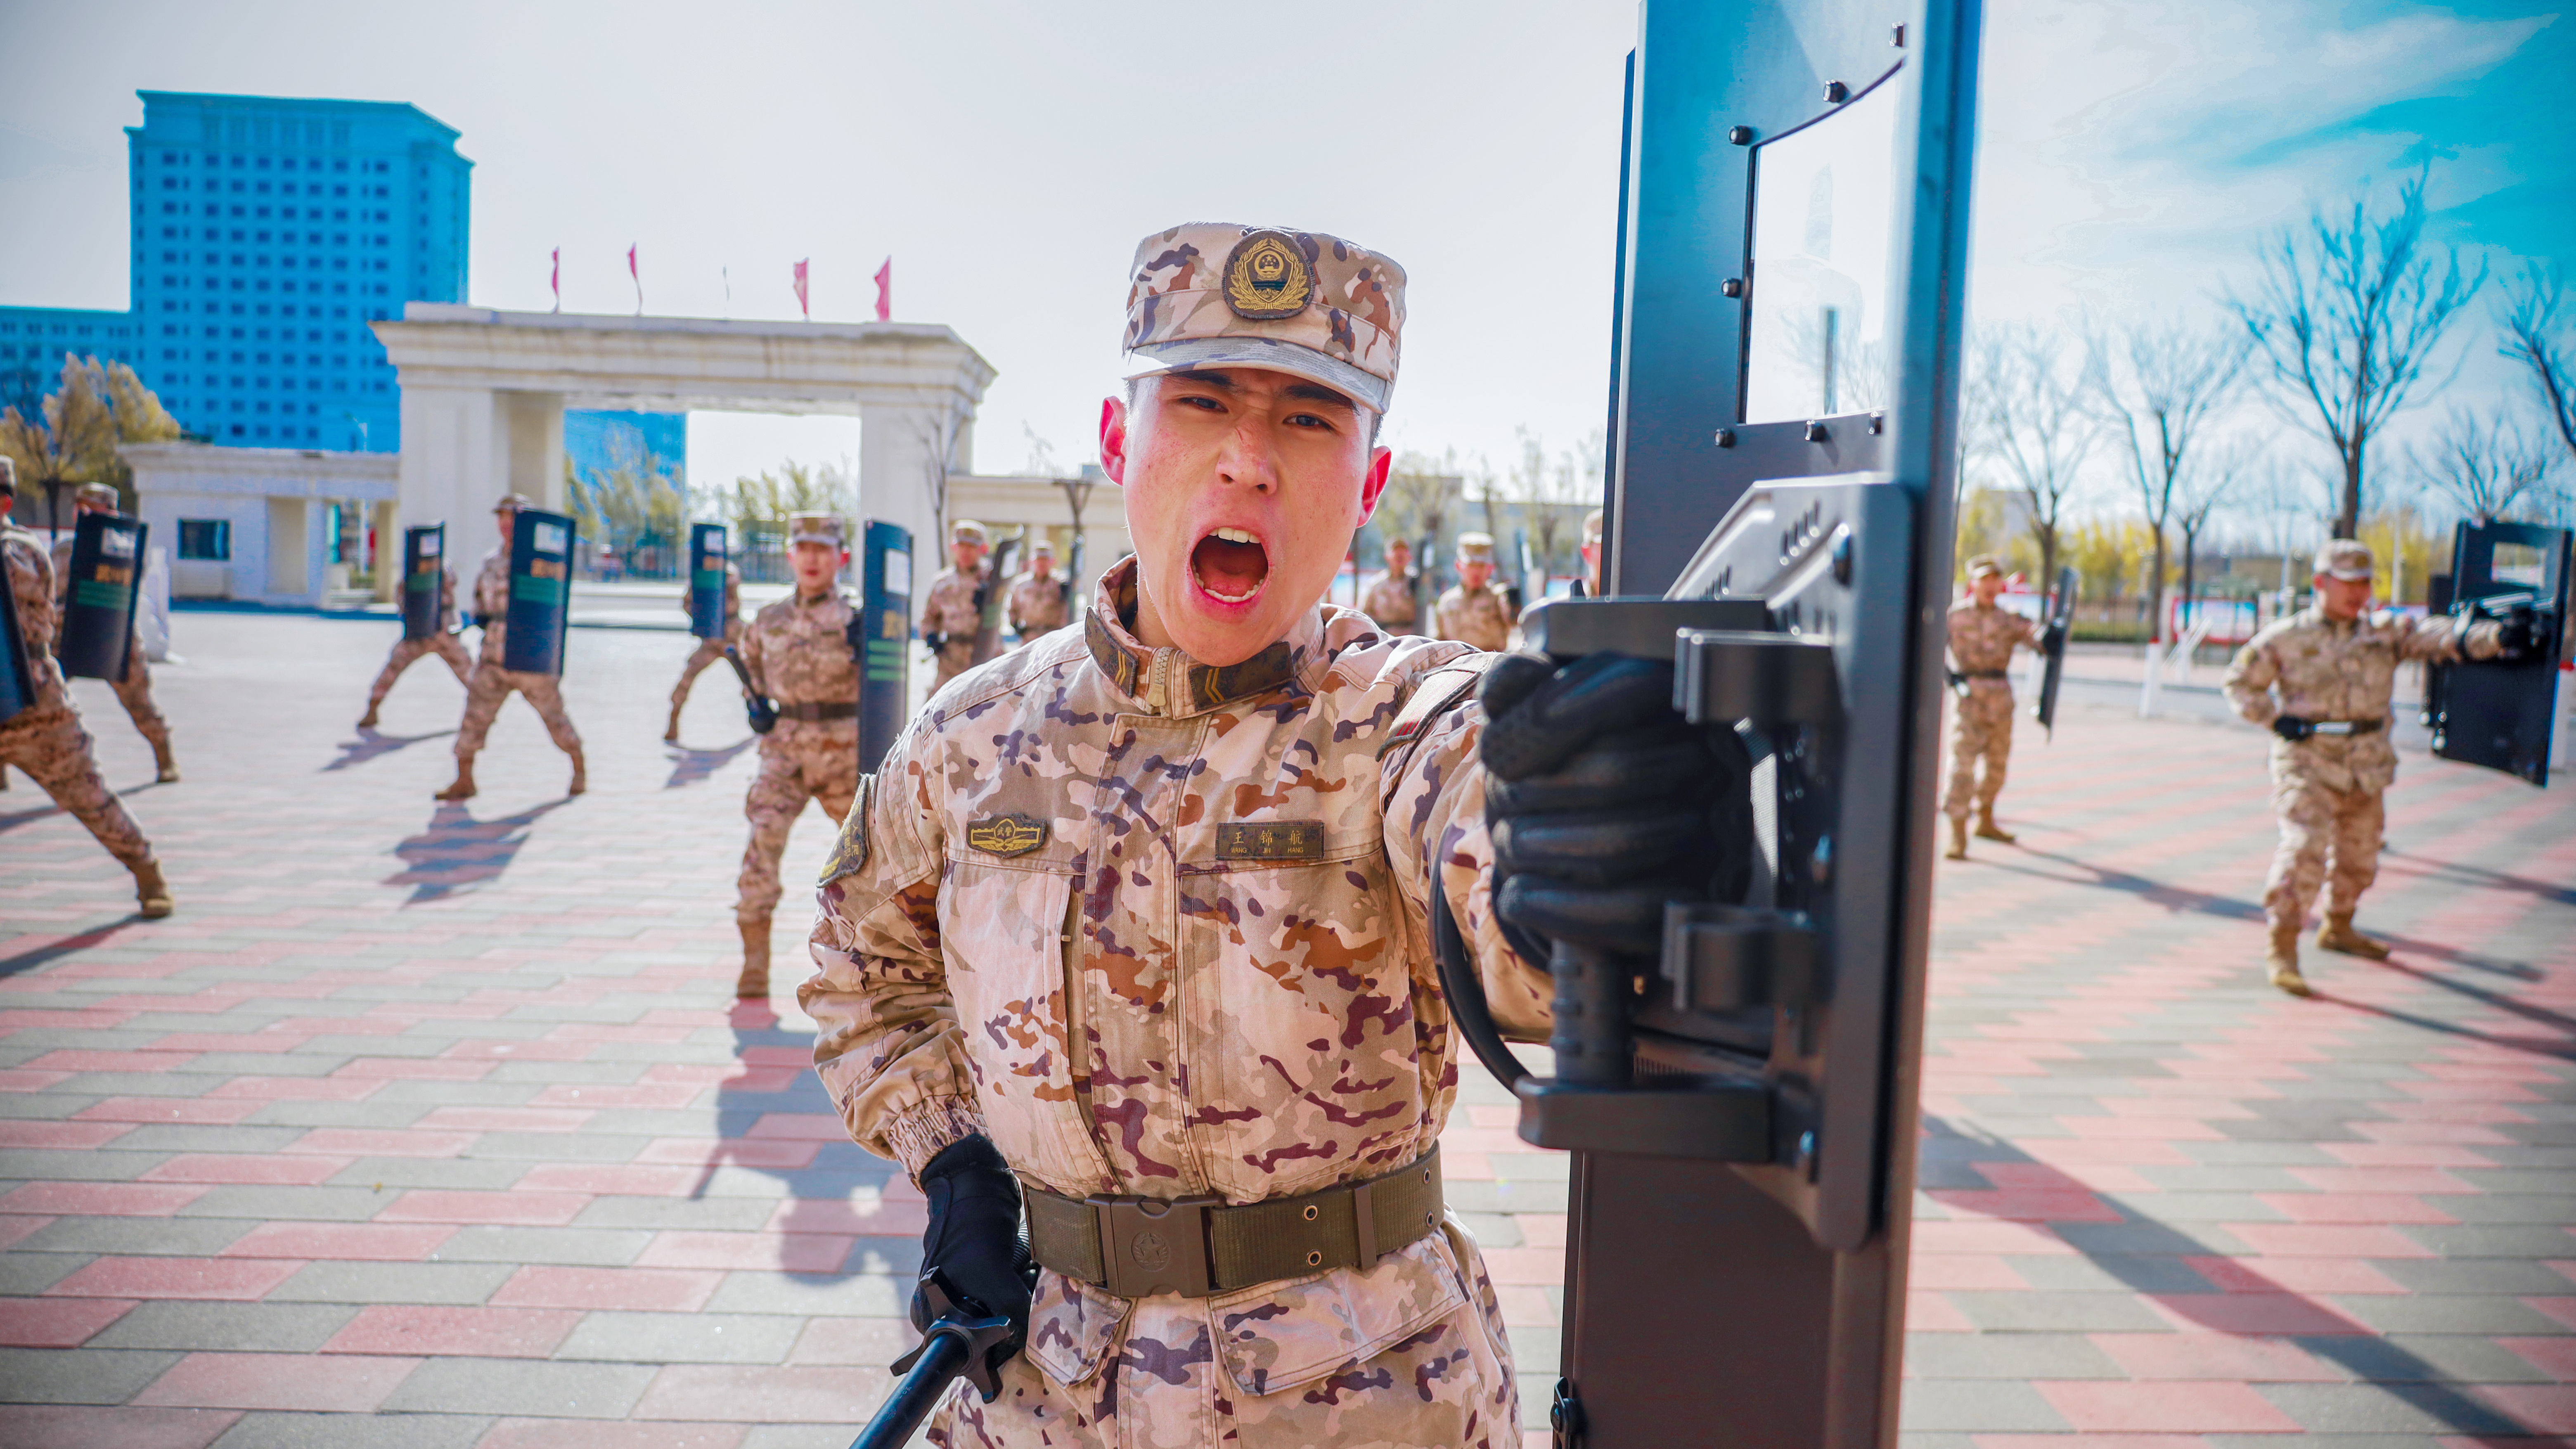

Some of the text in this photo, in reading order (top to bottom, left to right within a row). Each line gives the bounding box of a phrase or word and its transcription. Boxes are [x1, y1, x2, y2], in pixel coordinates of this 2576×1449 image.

[997, 826, 1012, 837] 武警
[1233, 830, 1302, 846] 王锦航
